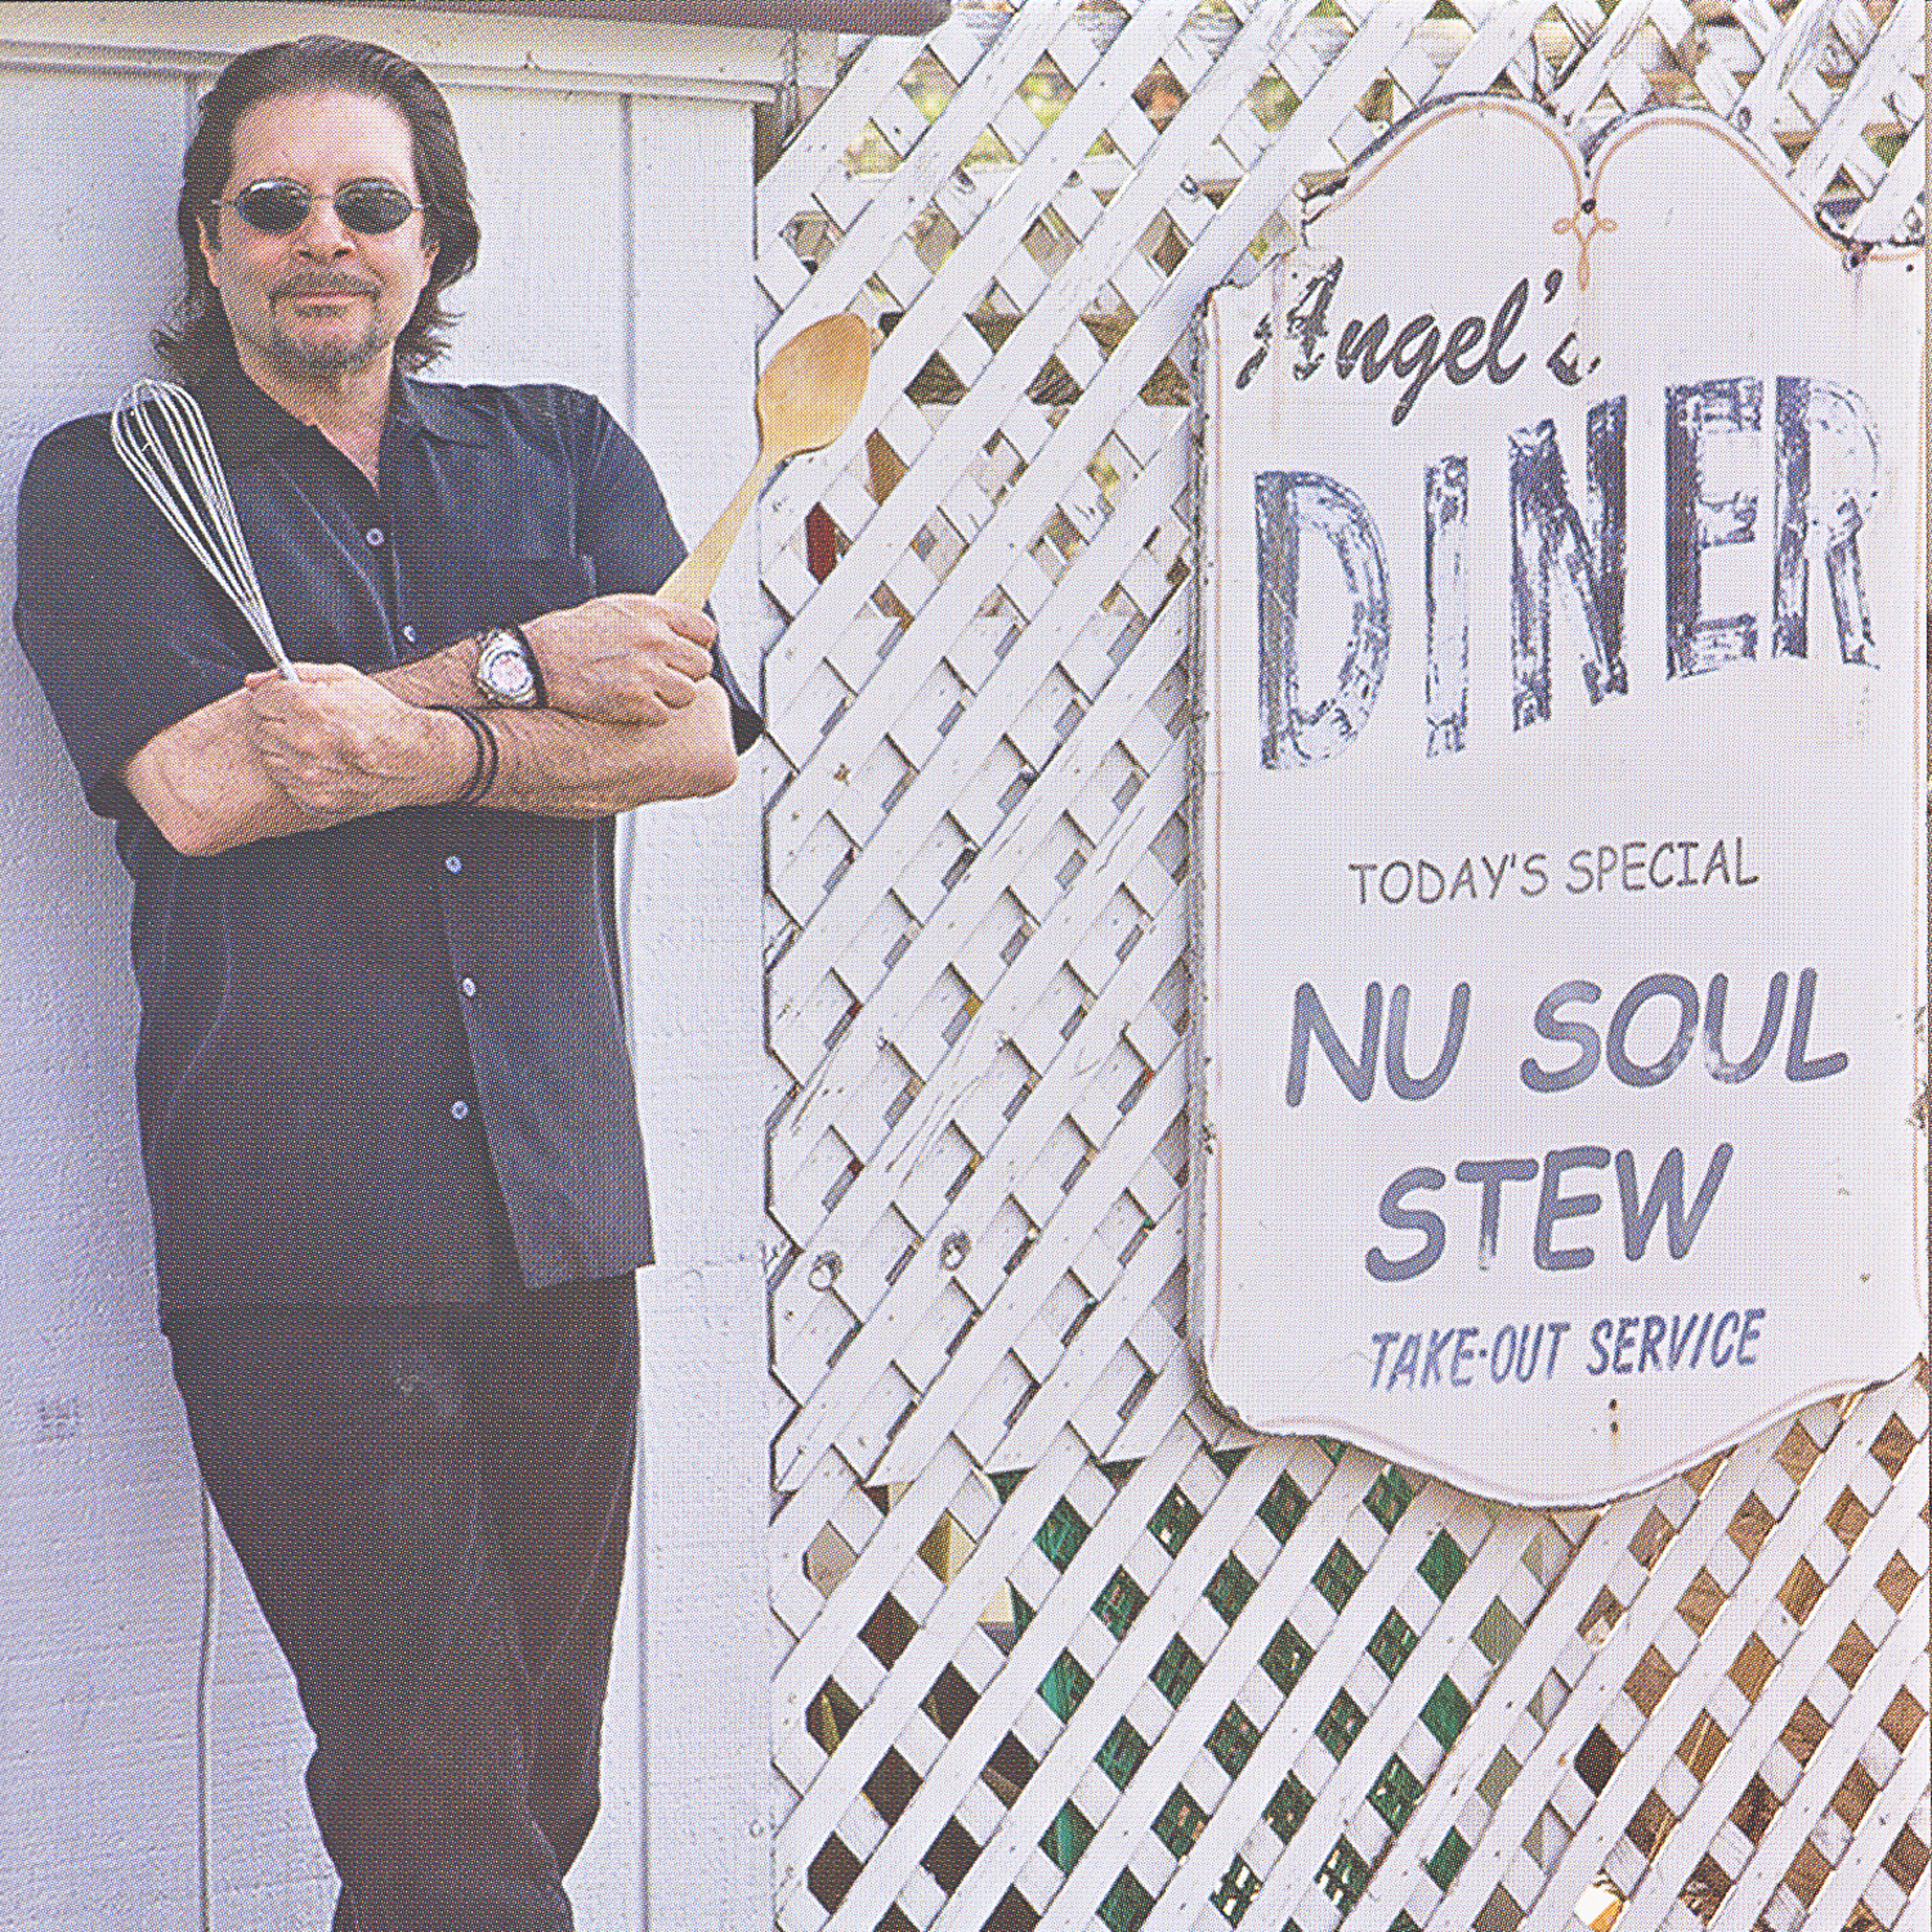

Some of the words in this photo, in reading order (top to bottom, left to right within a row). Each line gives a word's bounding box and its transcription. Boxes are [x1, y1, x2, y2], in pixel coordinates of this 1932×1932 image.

[1236, 256, 1601, 425] Angel's
[1254, 376, 1882, 770] DINER
[1349, 851, 1548, 904] TODAY'S
[1565, 837, 1760, 895] SPECIAL
[1286, 982, 1470, 1107] NU
[1520, 967, 1849, 1094] SOUL
[1365, 1142, 1734, 1282] STEW
[1587, 1308, 1766, 1376] SERVICE
